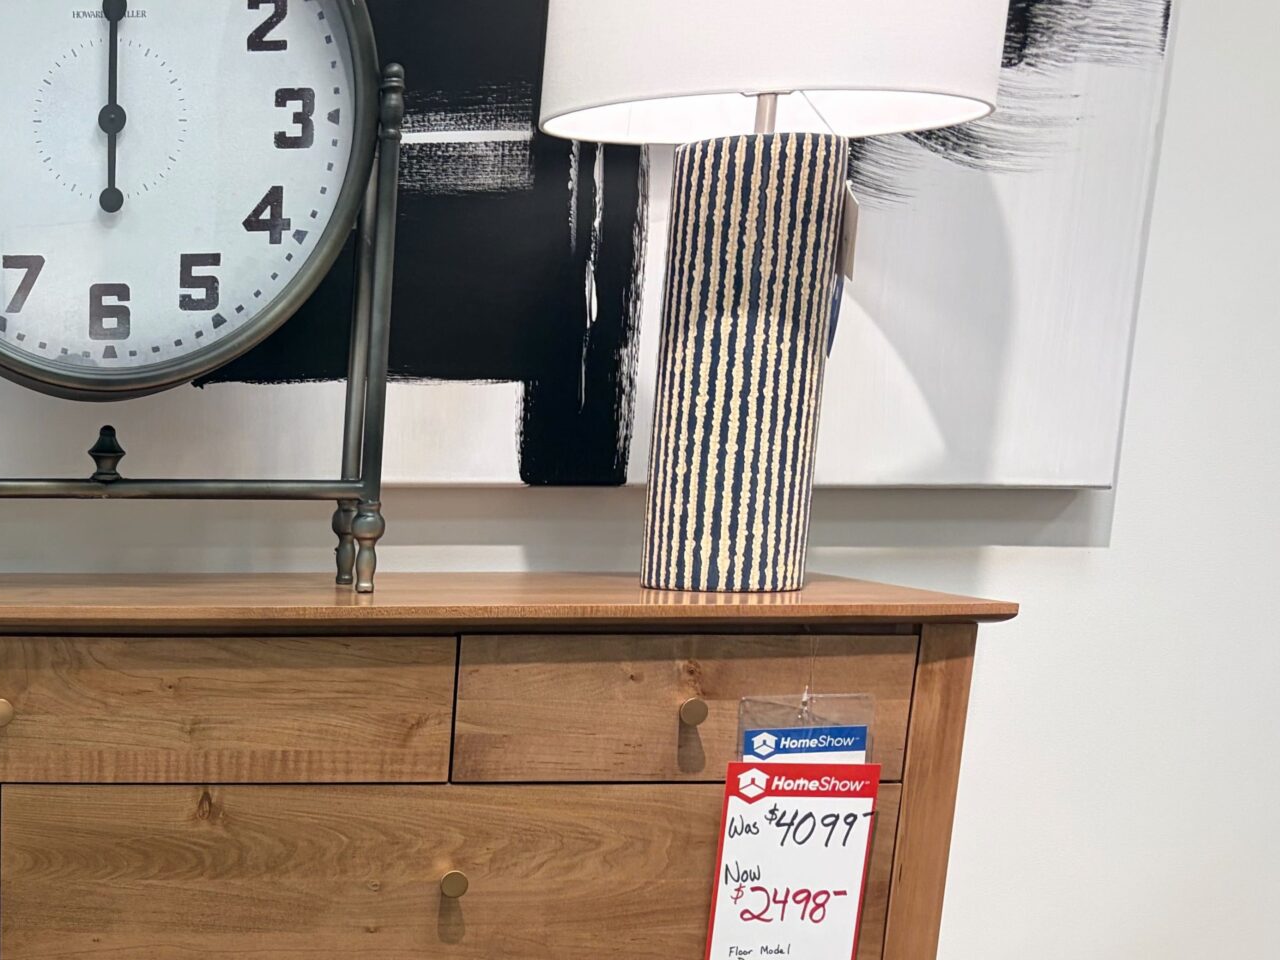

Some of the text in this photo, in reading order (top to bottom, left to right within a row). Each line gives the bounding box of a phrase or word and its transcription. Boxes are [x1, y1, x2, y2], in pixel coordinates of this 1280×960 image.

[247, 0, 288, 51] 2
[274, 88, 315, 149] 3
[242, 185, 290, 244] 4
[2, 255, 45, 313] 7
[179, 253, 221, 311] 5
[89, 283, 130, 340] 6
[780, 735, 855, 749] HomeShow
[771, 776, 865, 792] HomeShow
[728, 815, 760, 838] Was
[724, 861, 761, 884] Now
[728, 943, 790, 957] Floor Model
